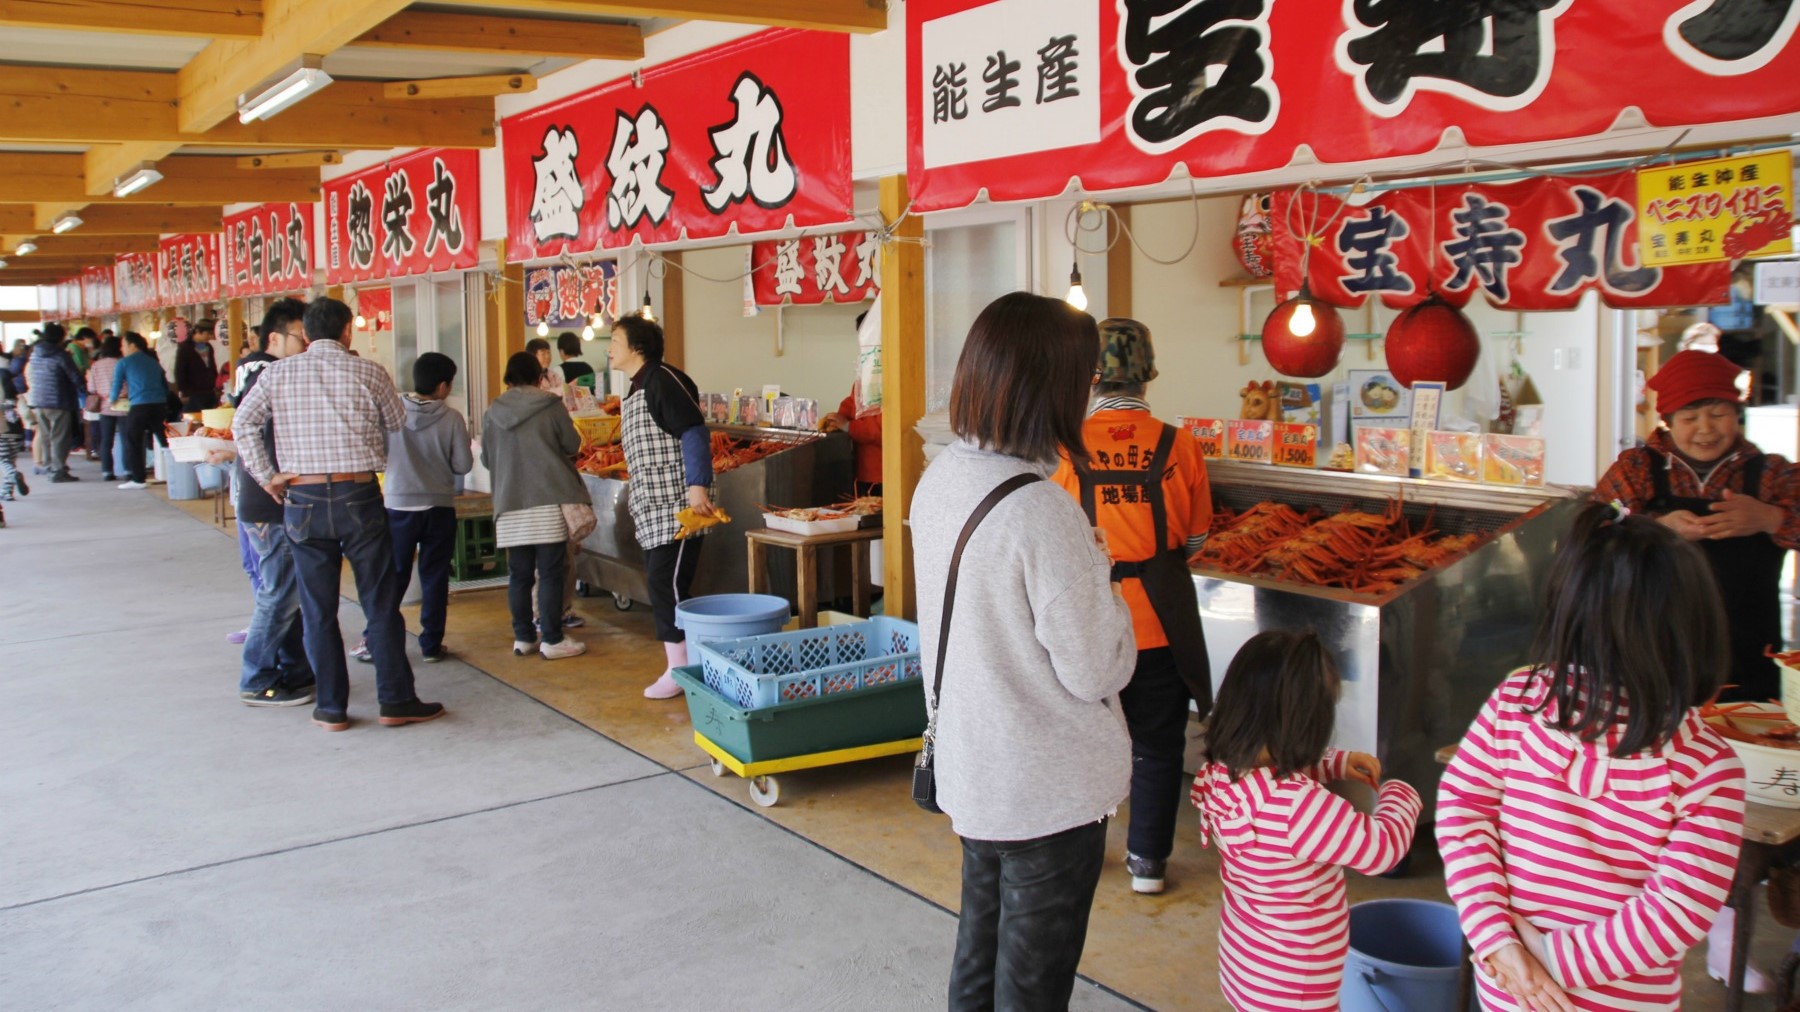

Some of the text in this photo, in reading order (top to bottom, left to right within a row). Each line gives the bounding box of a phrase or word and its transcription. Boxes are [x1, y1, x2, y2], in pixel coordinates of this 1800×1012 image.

[933, 34, 1080, 125] 能生産
[530, 69, 799, 246] 盛紋丸
[1337, 185, 1663, 303] 宝寿丸
